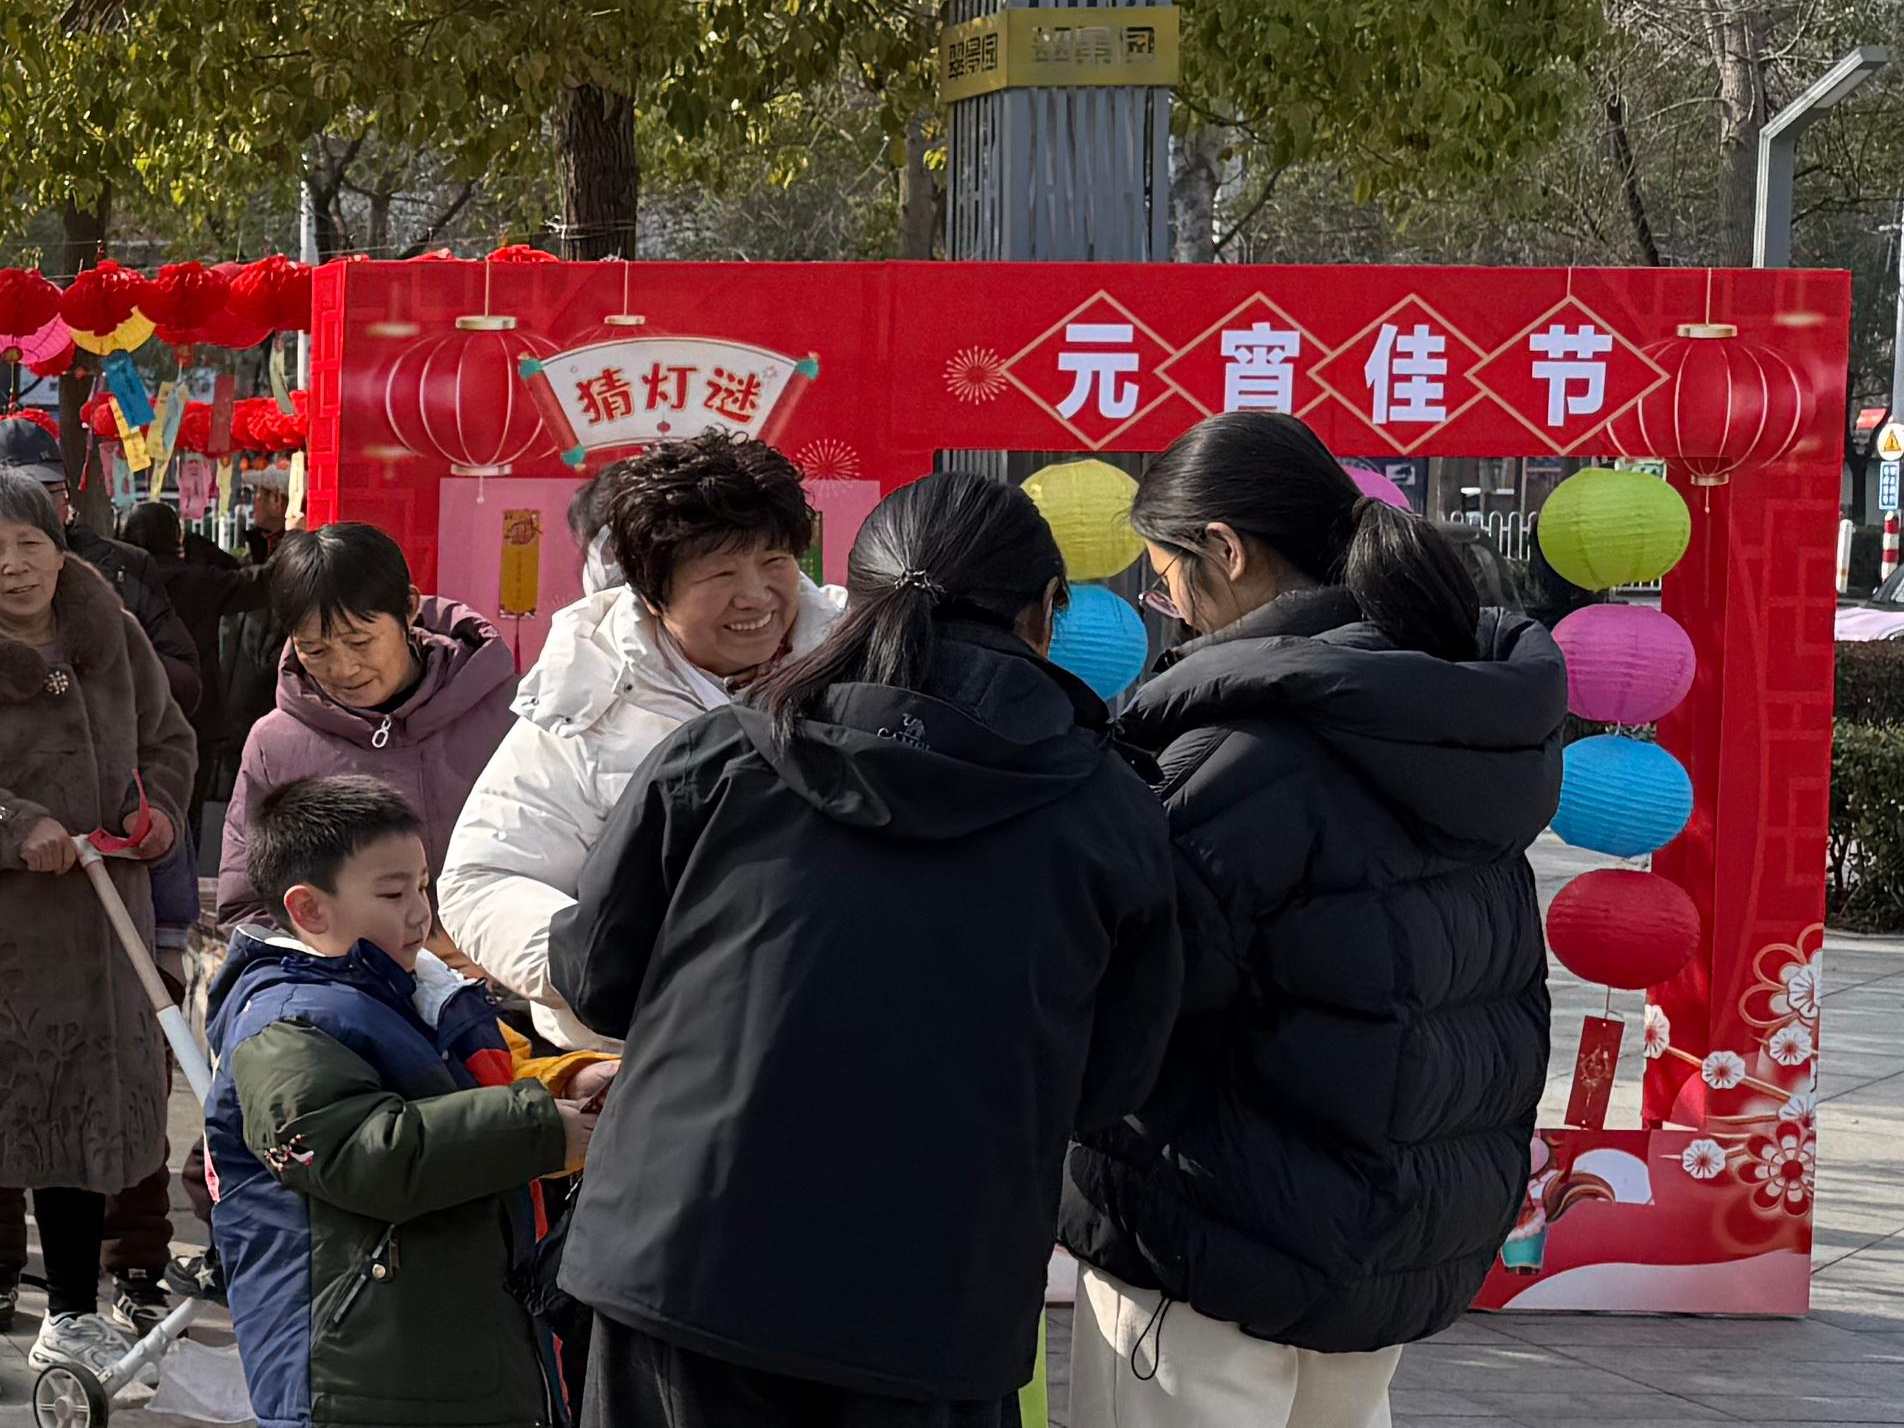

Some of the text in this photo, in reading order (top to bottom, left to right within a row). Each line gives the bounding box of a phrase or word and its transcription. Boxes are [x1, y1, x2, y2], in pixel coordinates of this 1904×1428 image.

[575, 362, 761, 423] 猜灯谜
[1059, 323, 1614, 424] 元宵佳节
